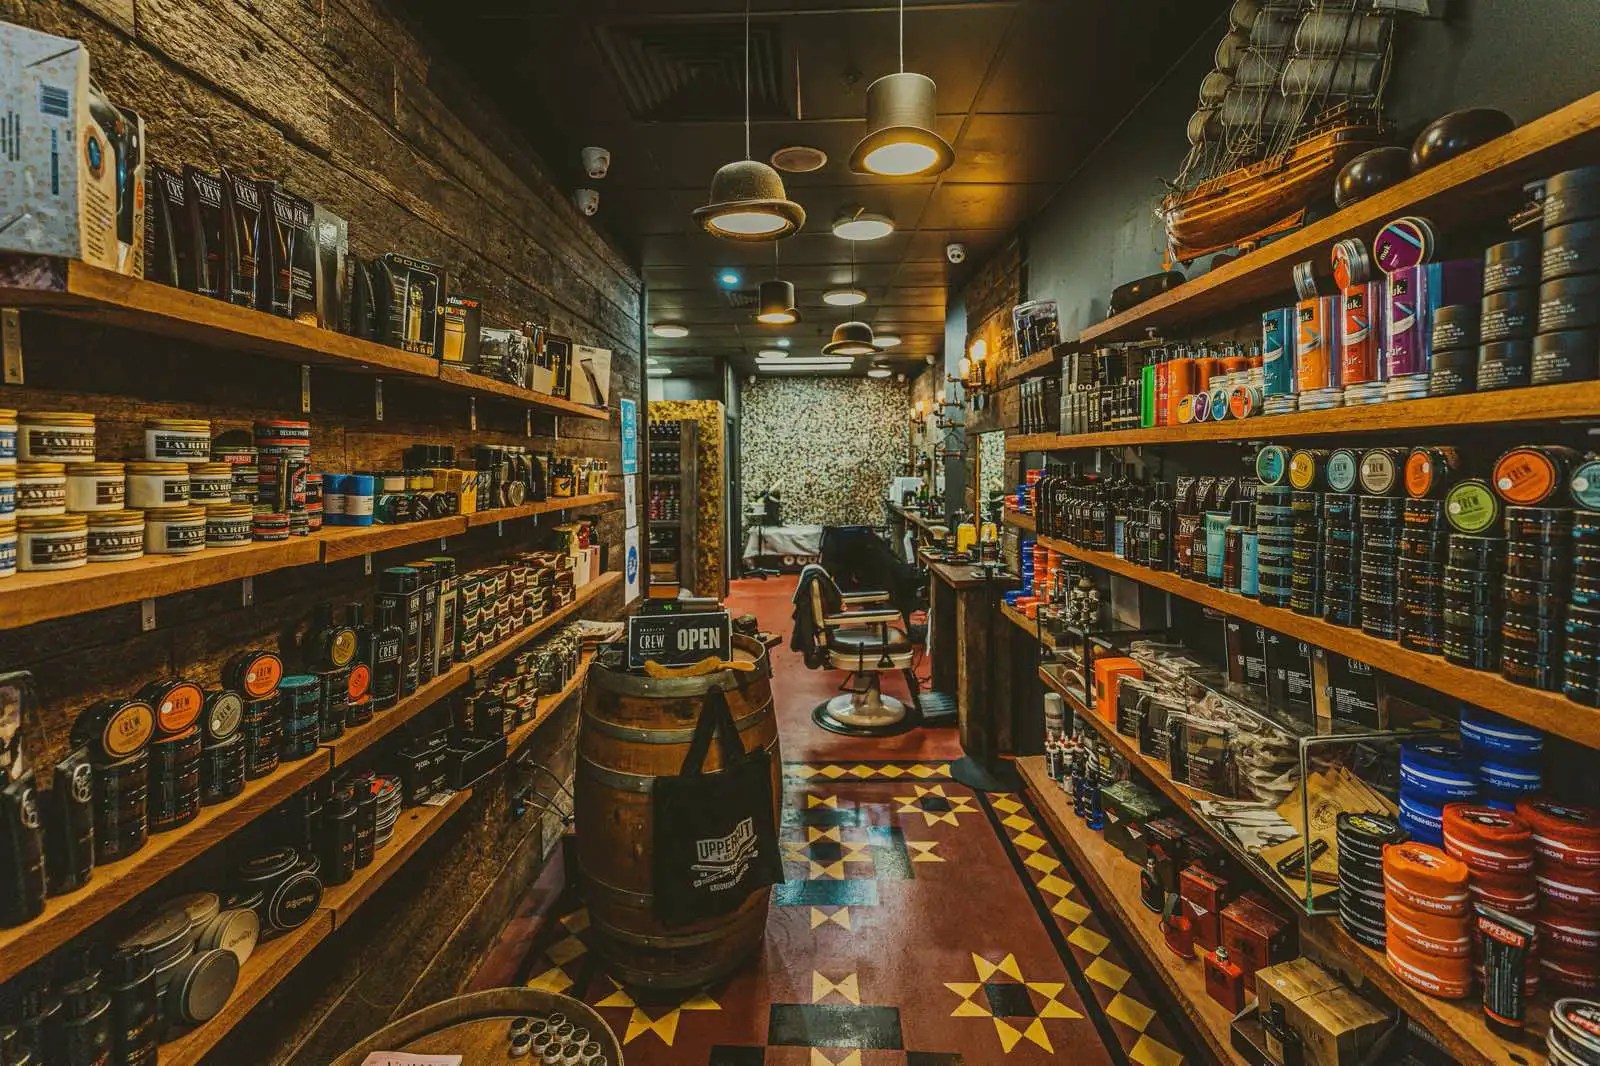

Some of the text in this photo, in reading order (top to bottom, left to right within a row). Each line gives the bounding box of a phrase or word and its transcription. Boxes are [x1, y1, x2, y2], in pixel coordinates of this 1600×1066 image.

[294, 207, 309, 226] REW
[639, 634, 665, 650] CREW
[676, 627, 720, 651] OPEN
[380, 645, 399, 659] CREW
[699, 822, 750, 859] UPPERUT
[1478, 917, 1524, 947] UPPERCUT
